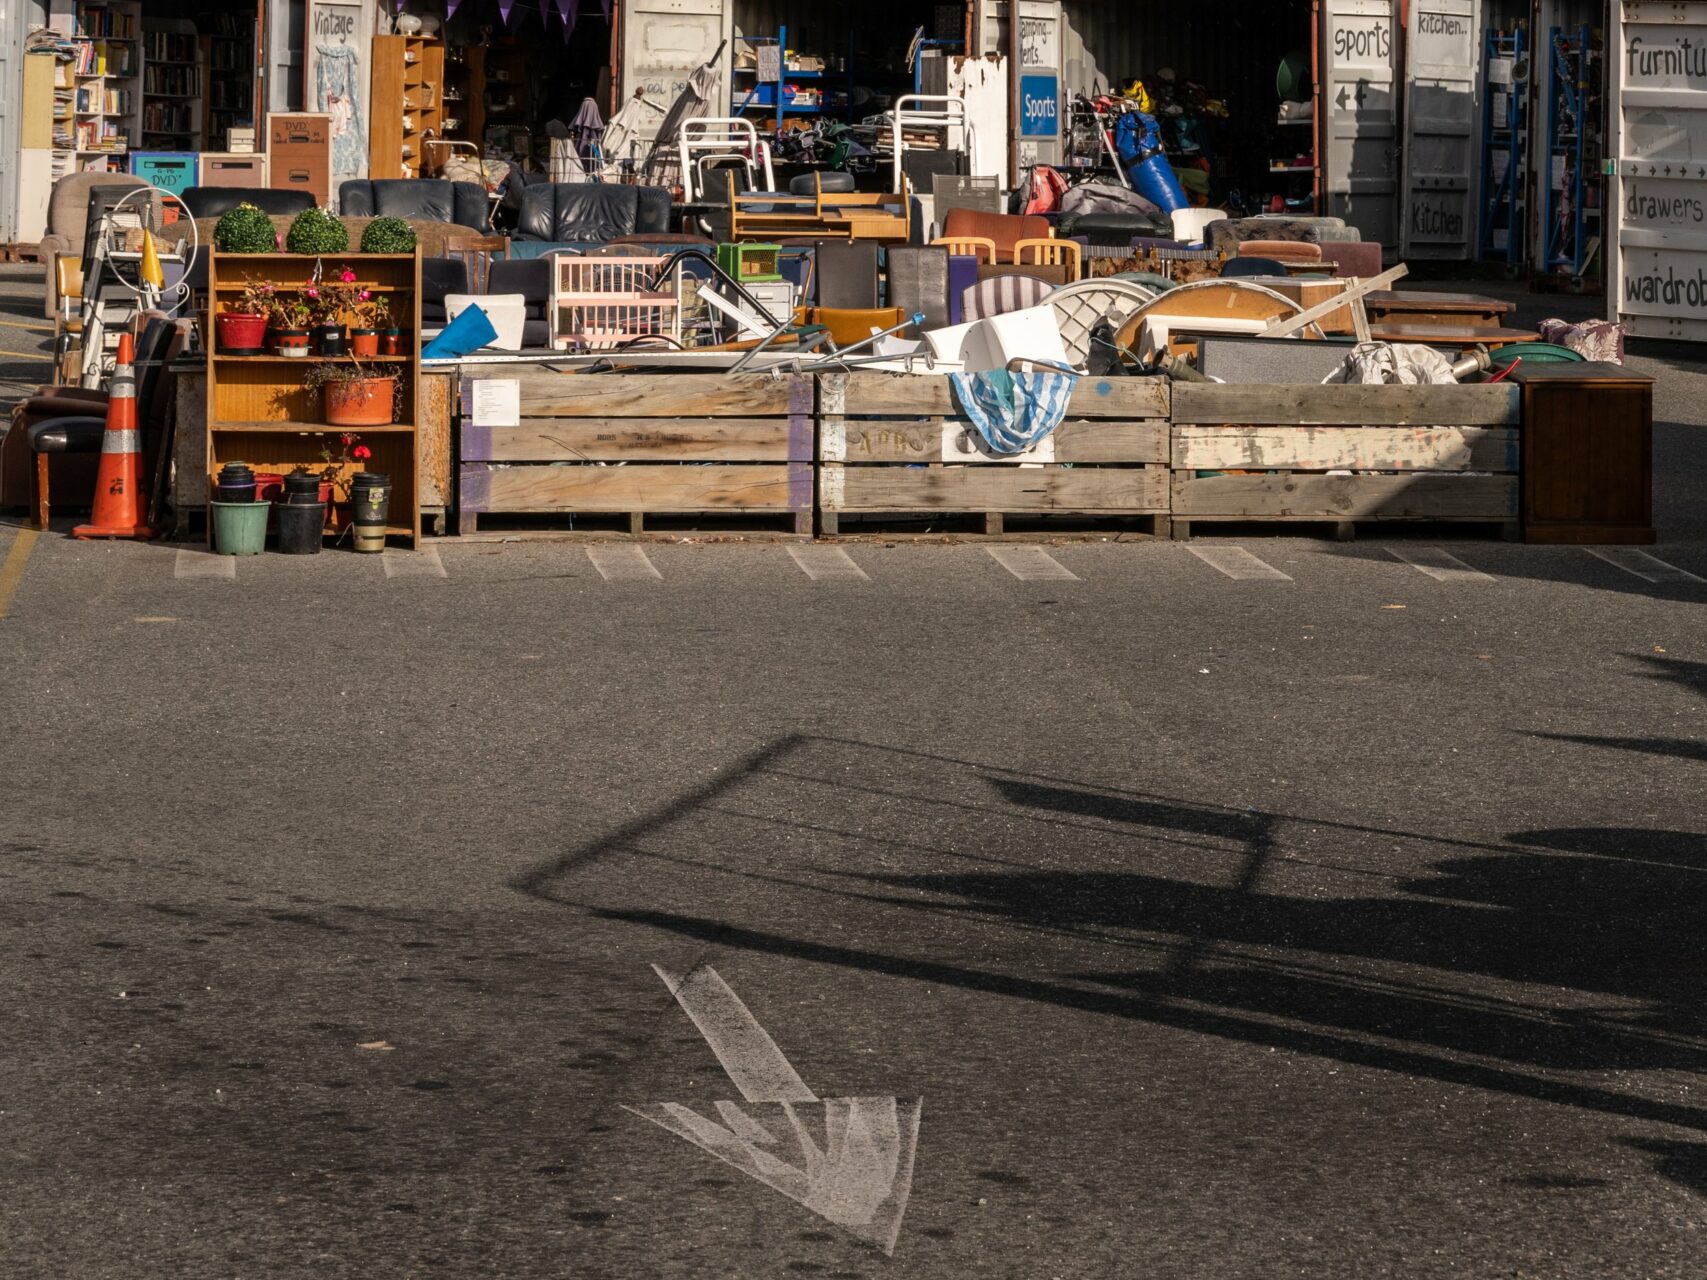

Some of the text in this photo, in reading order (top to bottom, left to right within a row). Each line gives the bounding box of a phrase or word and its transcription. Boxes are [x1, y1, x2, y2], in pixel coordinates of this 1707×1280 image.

[314, 8, 354, 44] Vintage
[1025, 93, 1056, 123] Sports
[1627, 184, 1704, 223] drawers
